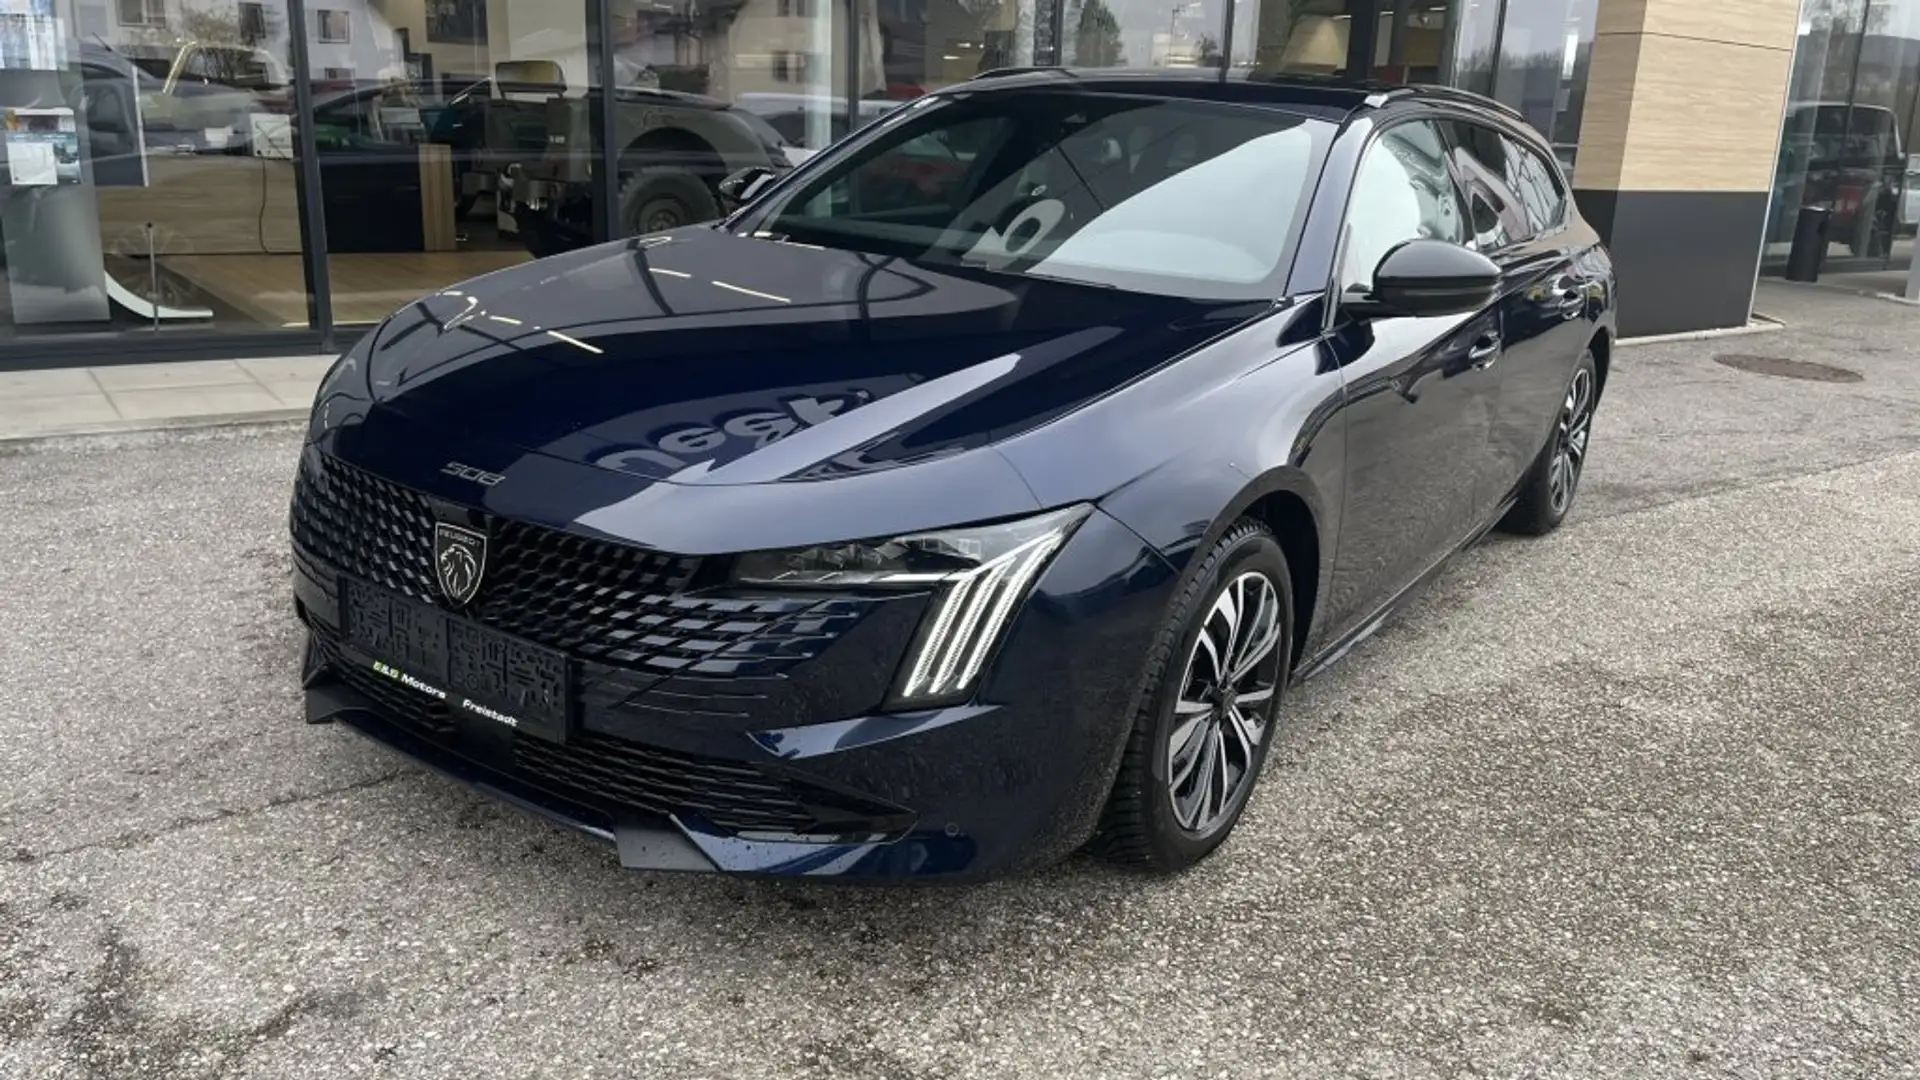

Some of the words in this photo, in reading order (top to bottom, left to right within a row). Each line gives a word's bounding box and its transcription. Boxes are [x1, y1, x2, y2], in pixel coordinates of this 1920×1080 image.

[440, 462, 506, 486] 508
[439, 529, 482, 546] PEUGEOT
[401, 673, 447, 699] Motors
[462, 698, 518, 727] Freistadt
